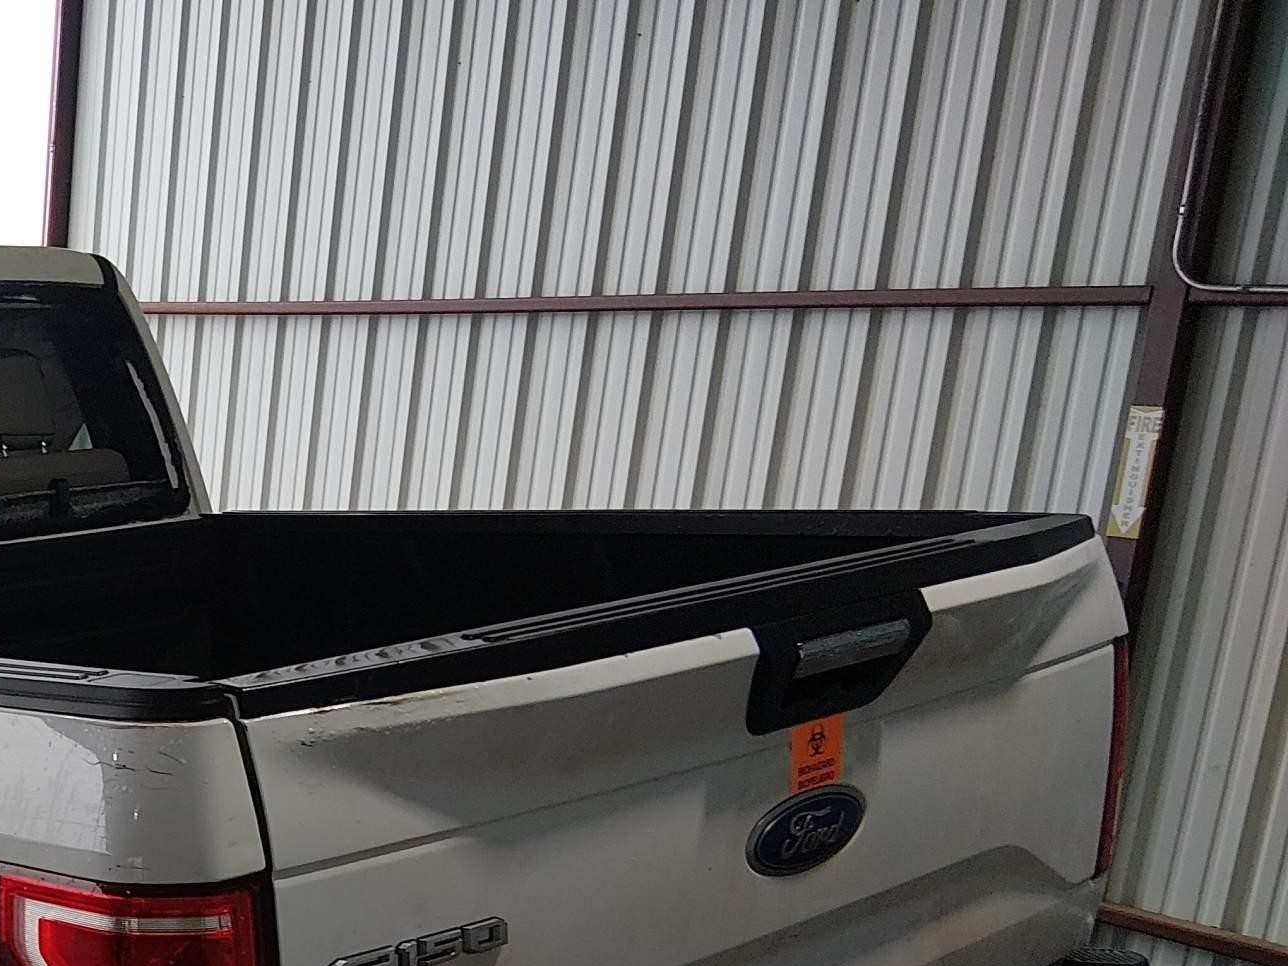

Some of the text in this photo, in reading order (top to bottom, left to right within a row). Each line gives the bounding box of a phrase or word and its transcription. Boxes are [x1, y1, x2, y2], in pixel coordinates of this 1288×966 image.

[1128, 416, 1163, 433] FIRE
[1120, 435, 1146, 528] EXTINGUISHER
[782, 806, 846, 859] Ford
